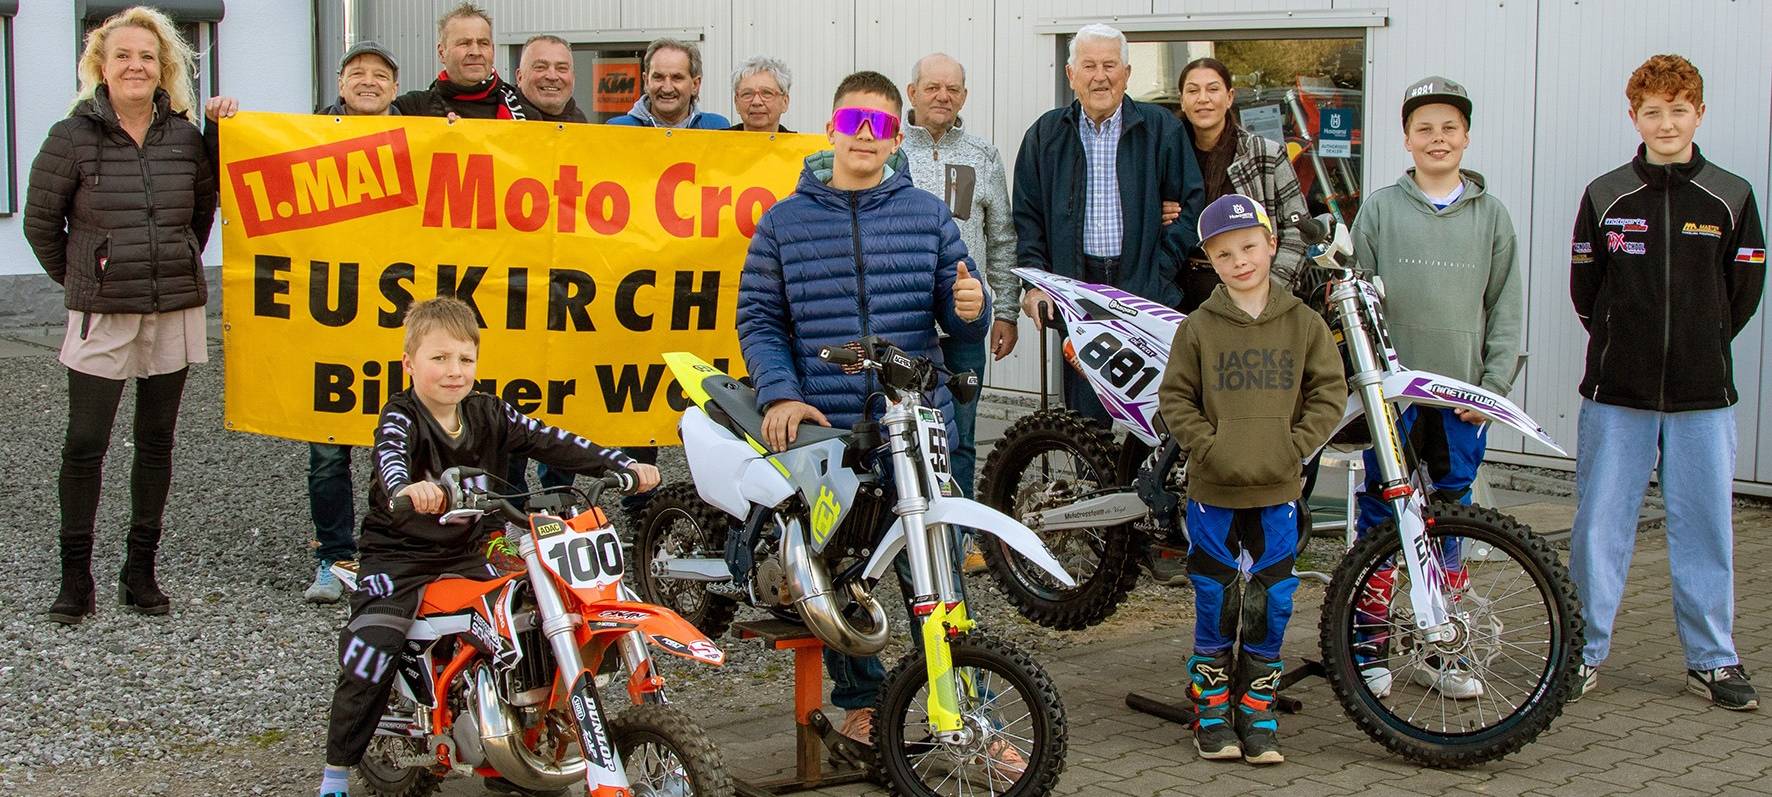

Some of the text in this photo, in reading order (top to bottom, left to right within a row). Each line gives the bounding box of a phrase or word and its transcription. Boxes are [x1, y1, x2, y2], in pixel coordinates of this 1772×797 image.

[598, 72, 635, 94] KTM
[242, 144, 401, 222] 1.MAI
[422, 152, 799, 239] Moto Cro
[254, 254, 745, 332] EUSKIRCH
[1078, 332, 1160, 400] 881
[1214, 371, 1294, 391] JONES
[1215, 351, 1295, 372] JACK&
[1431, 383, 1495, 407] NINETYTWO
[539, 524, 561, 535] ADAC
[549, 532, 623, 585] 100
[342, 635, 394, 684] FLY
[582, 696, 616, 774] DUNLOP
